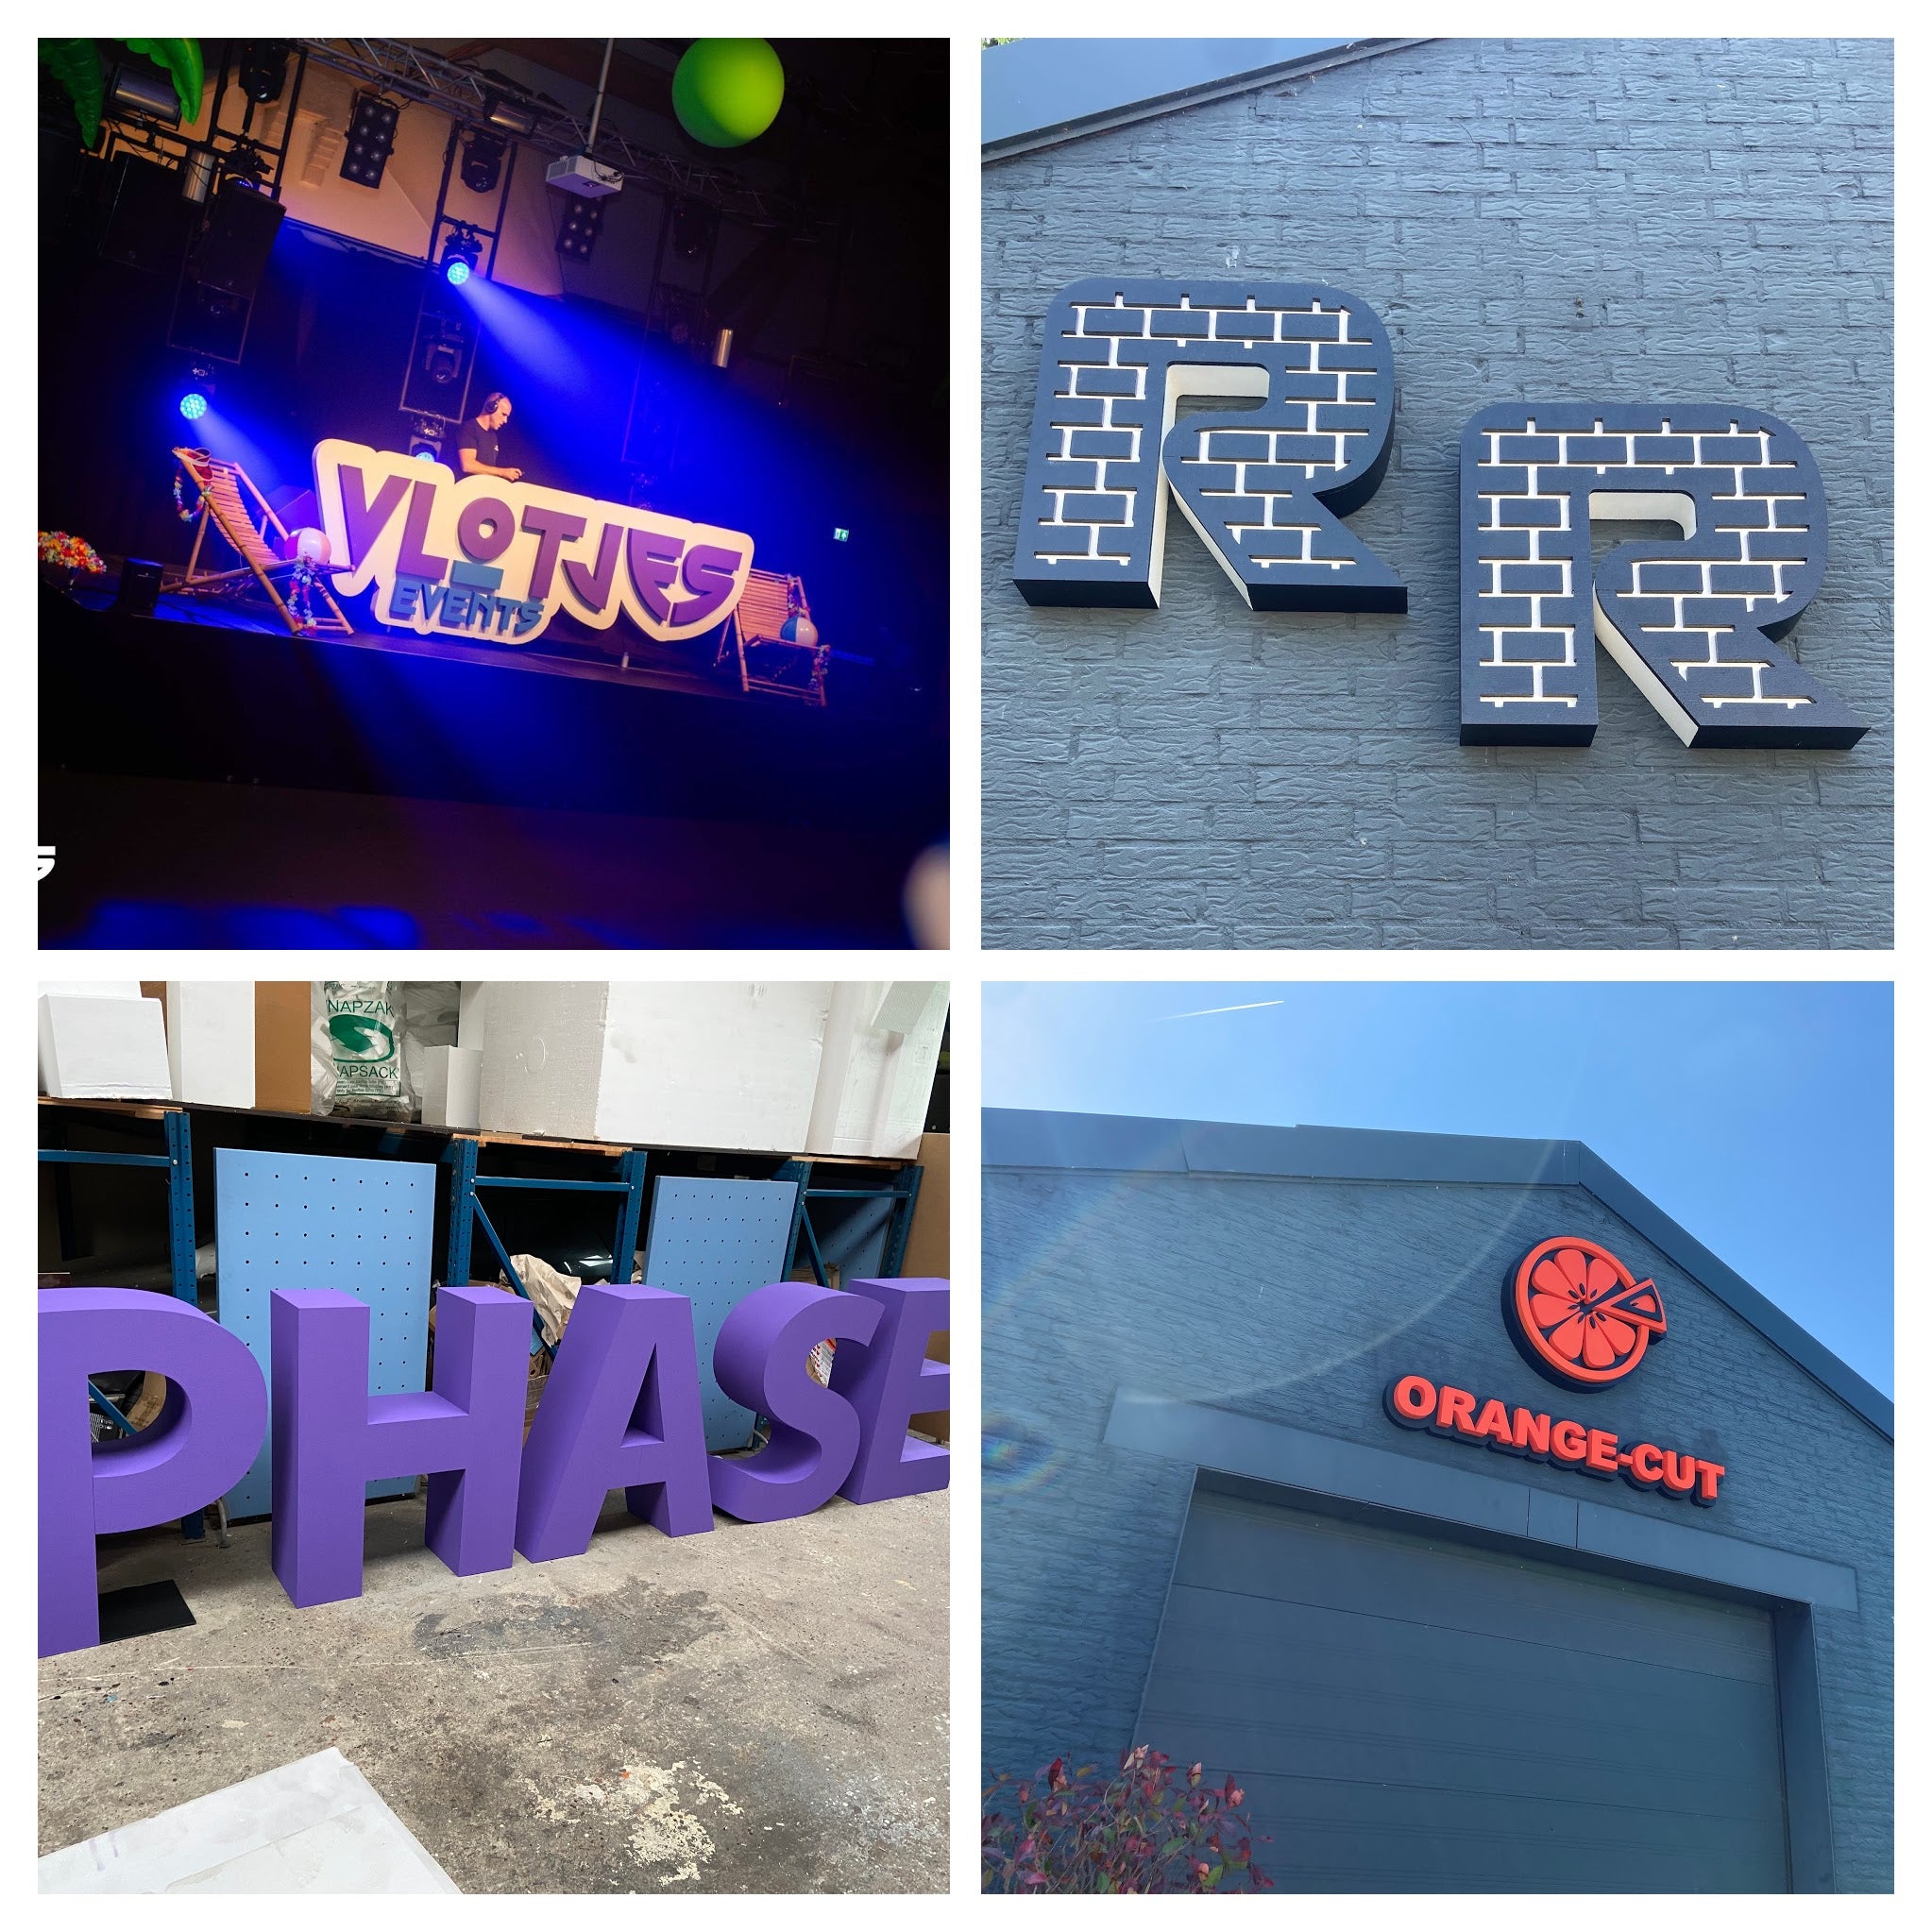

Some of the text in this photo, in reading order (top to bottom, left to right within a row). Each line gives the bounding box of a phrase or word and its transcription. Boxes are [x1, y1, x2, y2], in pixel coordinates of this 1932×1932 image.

[338, 463, 743, 625] VLOTJES
[1013, 277, 1872, 749] R R
[389, 579, 545, 638] EVENTS
[327, 999, 396, 1018] NAPZAK
[334, 1064, 398, 1078] APSACK
[38, 1278, 950, 1659] PHASE
[1393, 1375, 1725, 1500] ORANGE-CUT
